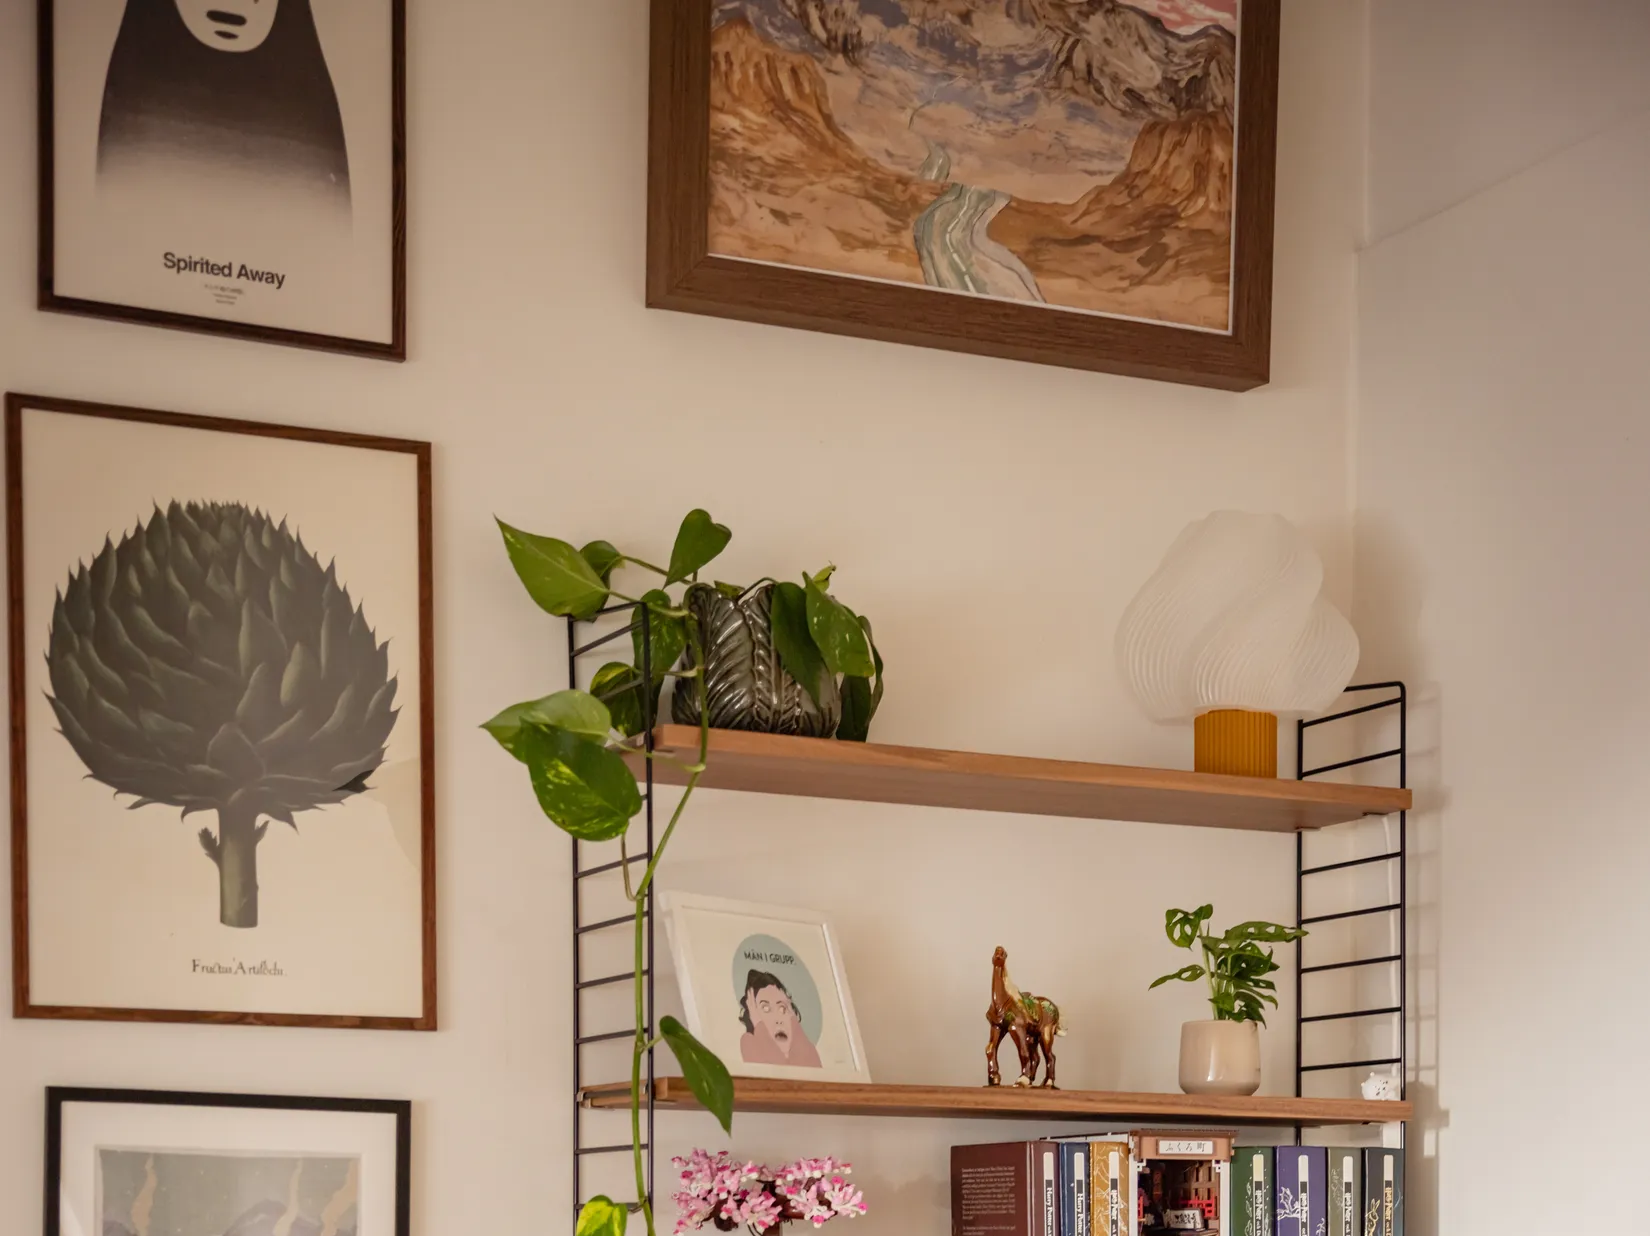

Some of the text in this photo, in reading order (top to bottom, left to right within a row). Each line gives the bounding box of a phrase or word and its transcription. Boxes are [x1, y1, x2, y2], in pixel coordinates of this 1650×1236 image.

[163, 251, 232, 278] Spirited
[236, 263, 286, 290] Away
[1045, 1187, 1053, 1206] Harry
[1076, 1193, 1084, 1212] Harry
